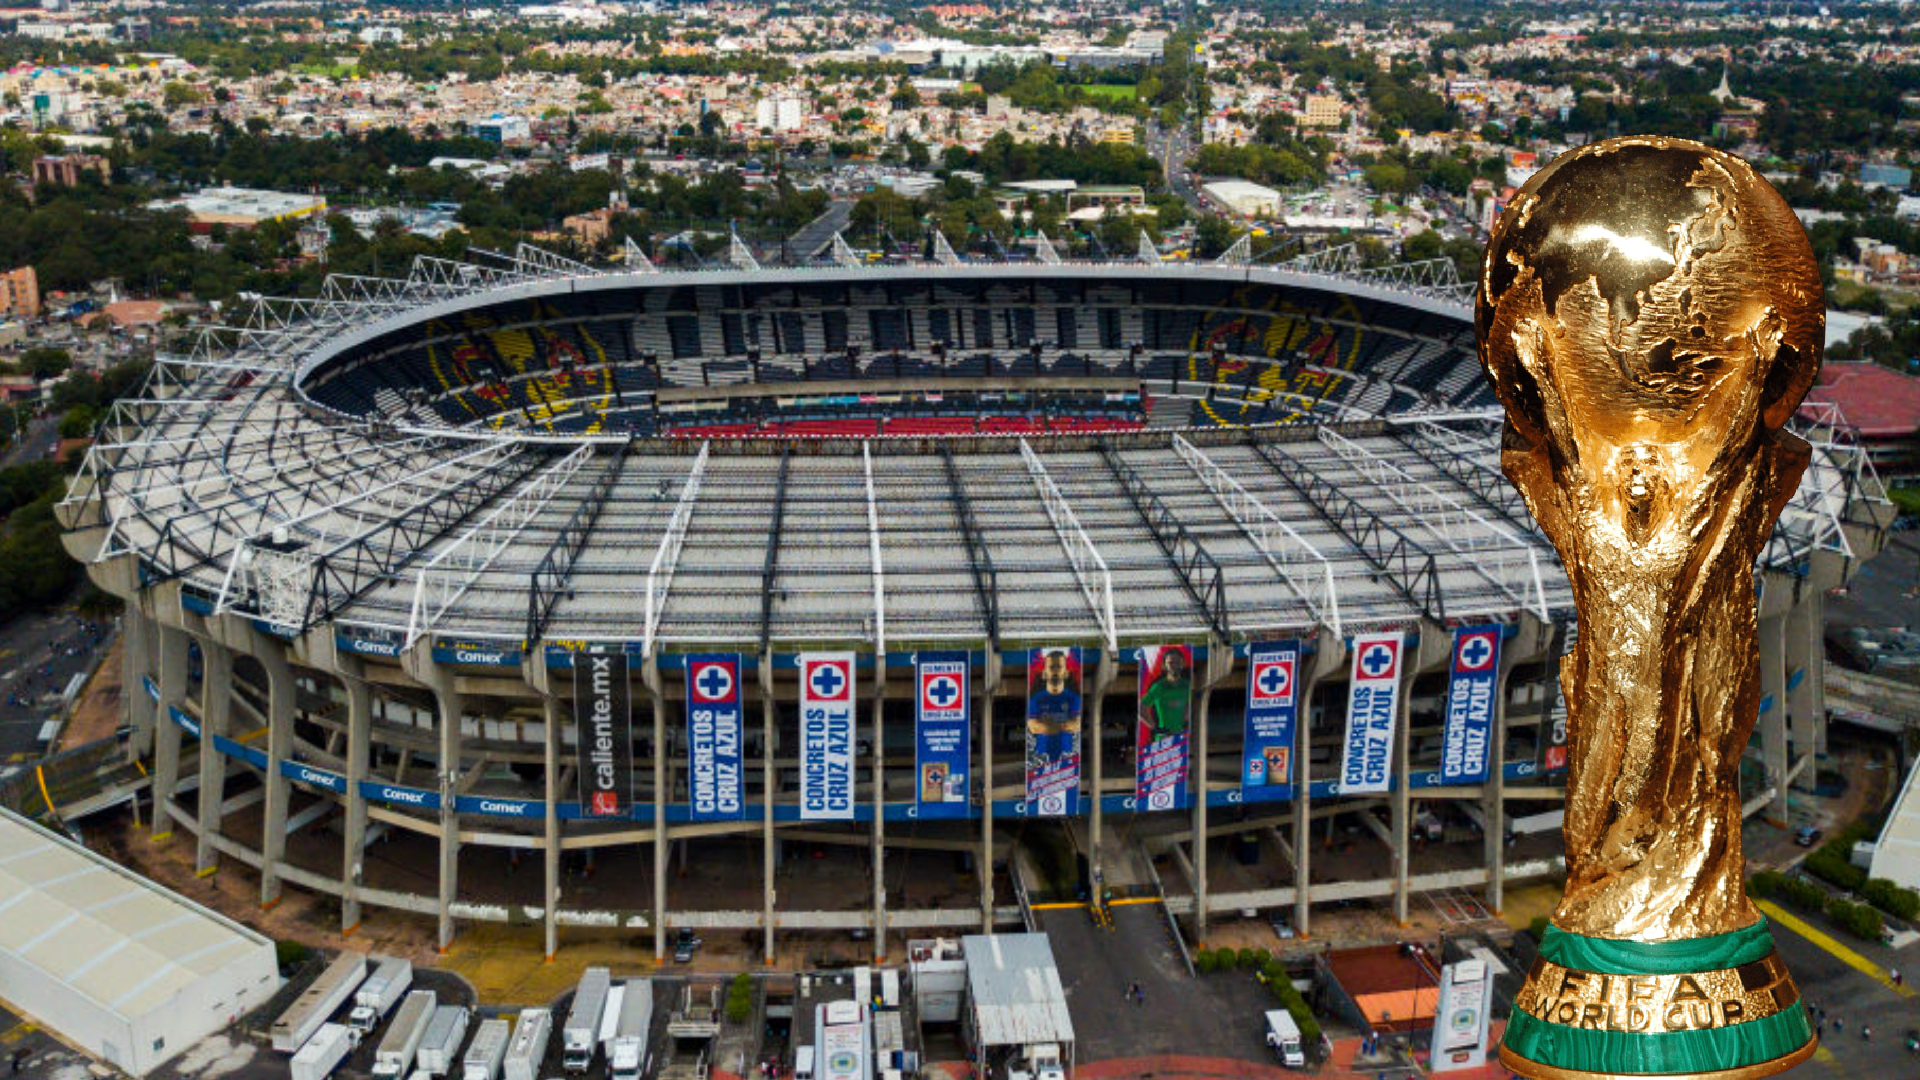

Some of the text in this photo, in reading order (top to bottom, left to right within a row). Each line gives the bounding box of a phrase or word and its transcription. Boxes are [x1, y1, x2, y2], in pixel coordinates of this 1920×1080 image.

[354, 639, 397, 656] Comex
[456, 649, 502, 664] Comex
[592, 657, 614, 790] caliente.mx
[692, 710, 715, 813] CONCRETOS
[715, 710, 738, 813] CRUZ AZUL
[806, 708, 825, 810] CONCRETOS
[828, 709, 848, 811] CRUZ AZUL
[1346, 687, 1371, 785] CONCRETOS
[1365, 686, 1393, 784] CRUZ AZUL
[1444, 678, 1470, 777] CONCRETOS
[1464, 677, 1491, 775] CRUZ AZUL
[301, 768, 336, 787] Comex
[382, 788, 426, 804] Comex
[480, 800, 526, 815] Comex
[1534, 996, 1744, 1032] WORLD CUP
[1559, 969, 1709, 1002] FIFA
